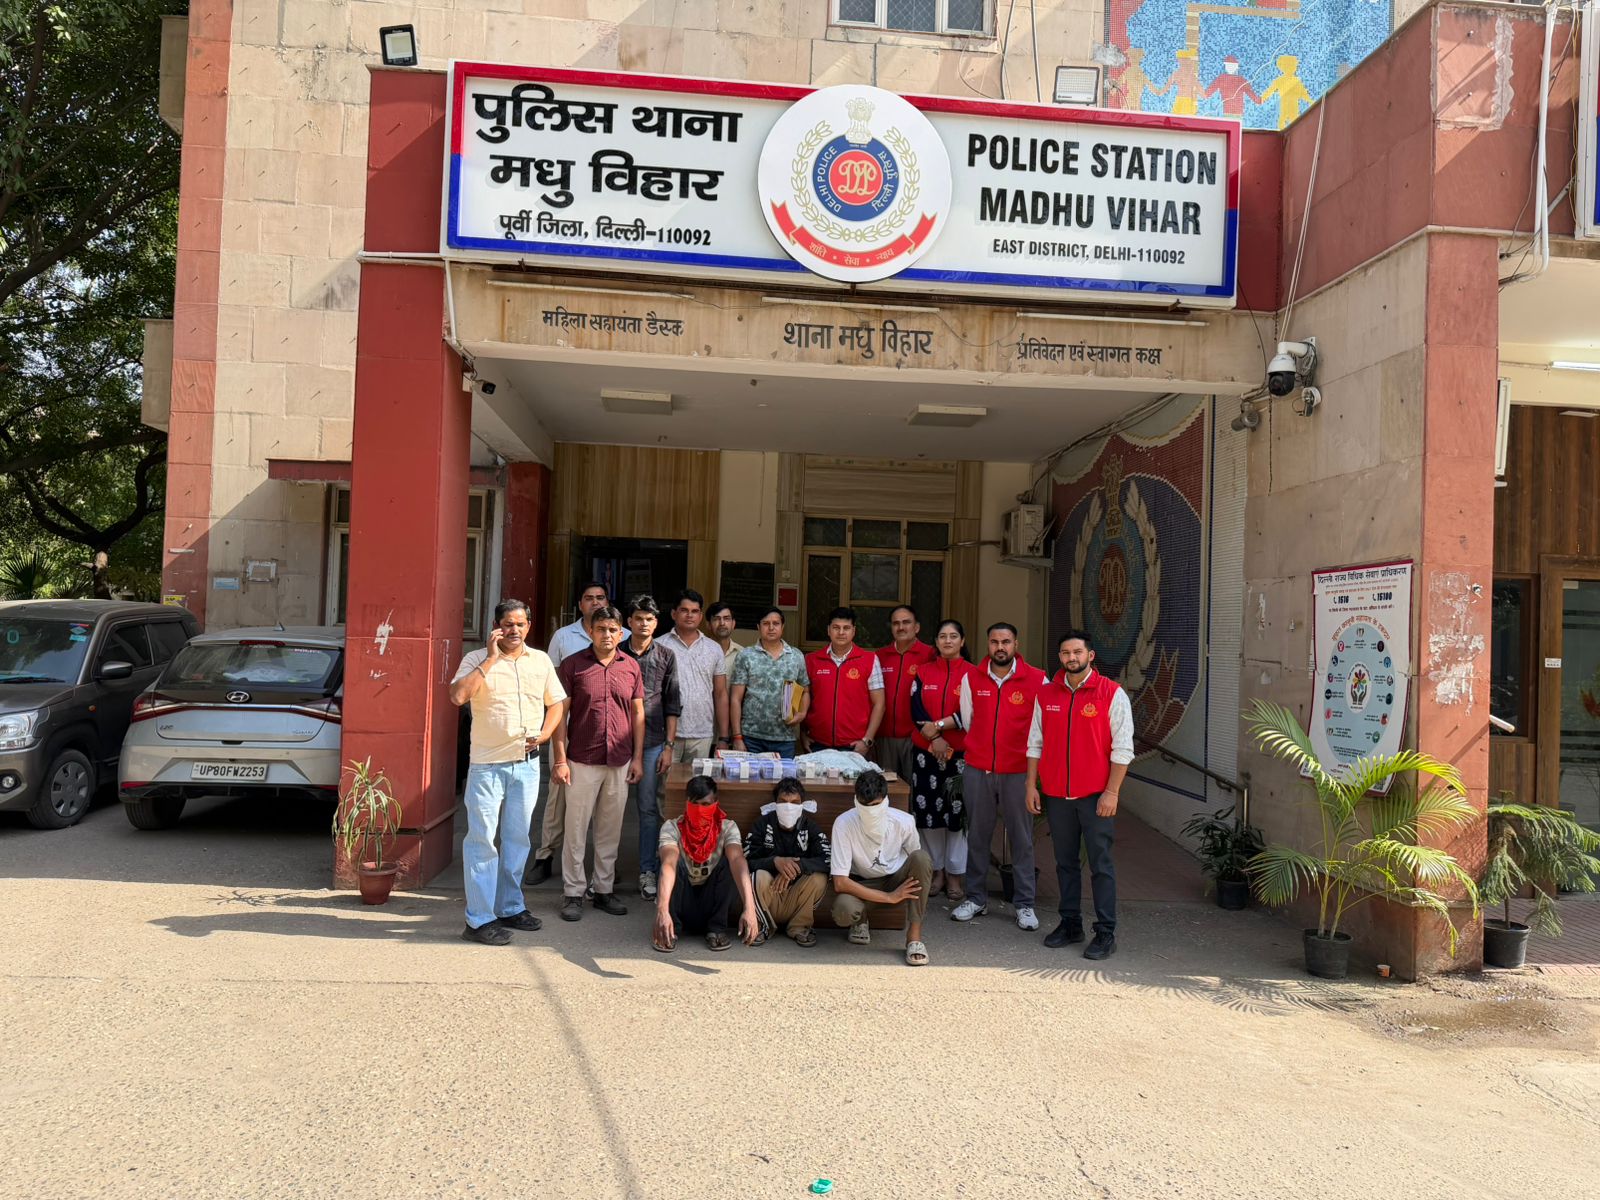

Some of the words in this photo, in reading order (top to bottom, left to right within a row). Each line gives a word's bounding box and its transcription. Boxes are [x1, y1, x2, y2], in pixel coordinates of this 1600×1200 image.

[472, 83, 618, 144] पुलिस
[632, 106, 743, 143] थाना
[817, 145, 838, 182] POLICE
[877, 150, 898, 180] पुलिस
[967, 133, 1080, 176] POLICE
[1090, 142, 1217, 185] STATION
[489, 154, 576, 208] मधु
[588, 149, 725, 201] विहार
[818, 184, 842, 213] DELHI
[871, 183, 895, 212] दिल्ली
[979, 186, 1095, 228] MADHU
[1106, 195, 1202, 235] VIHAR
[499, 209, 532, 240] पूर्वी
[537, 210, 589, 239] जिला,
[596, 216, 712, 246] दिल्ली-110092
[844, 254, 860, 266] सेवा
[993, 238, 1025, 254] EAST
[1029, 240, 1090, 260] DISTRICT,
[1093, 244, 1186, 264] DELHI-110092
[542, 305, 588, 333] महिला
[783, 322, 834, 349] थाना
[880, 319, 934, 357] विहार
[1017, 337, 1066, 364] प्रतिवेदन
[1087, 345, 1133, 364] स्वागत
[1135, 347, 1163, 365] कक्ष
[199, 764, 265, 778] UP80FW2253
